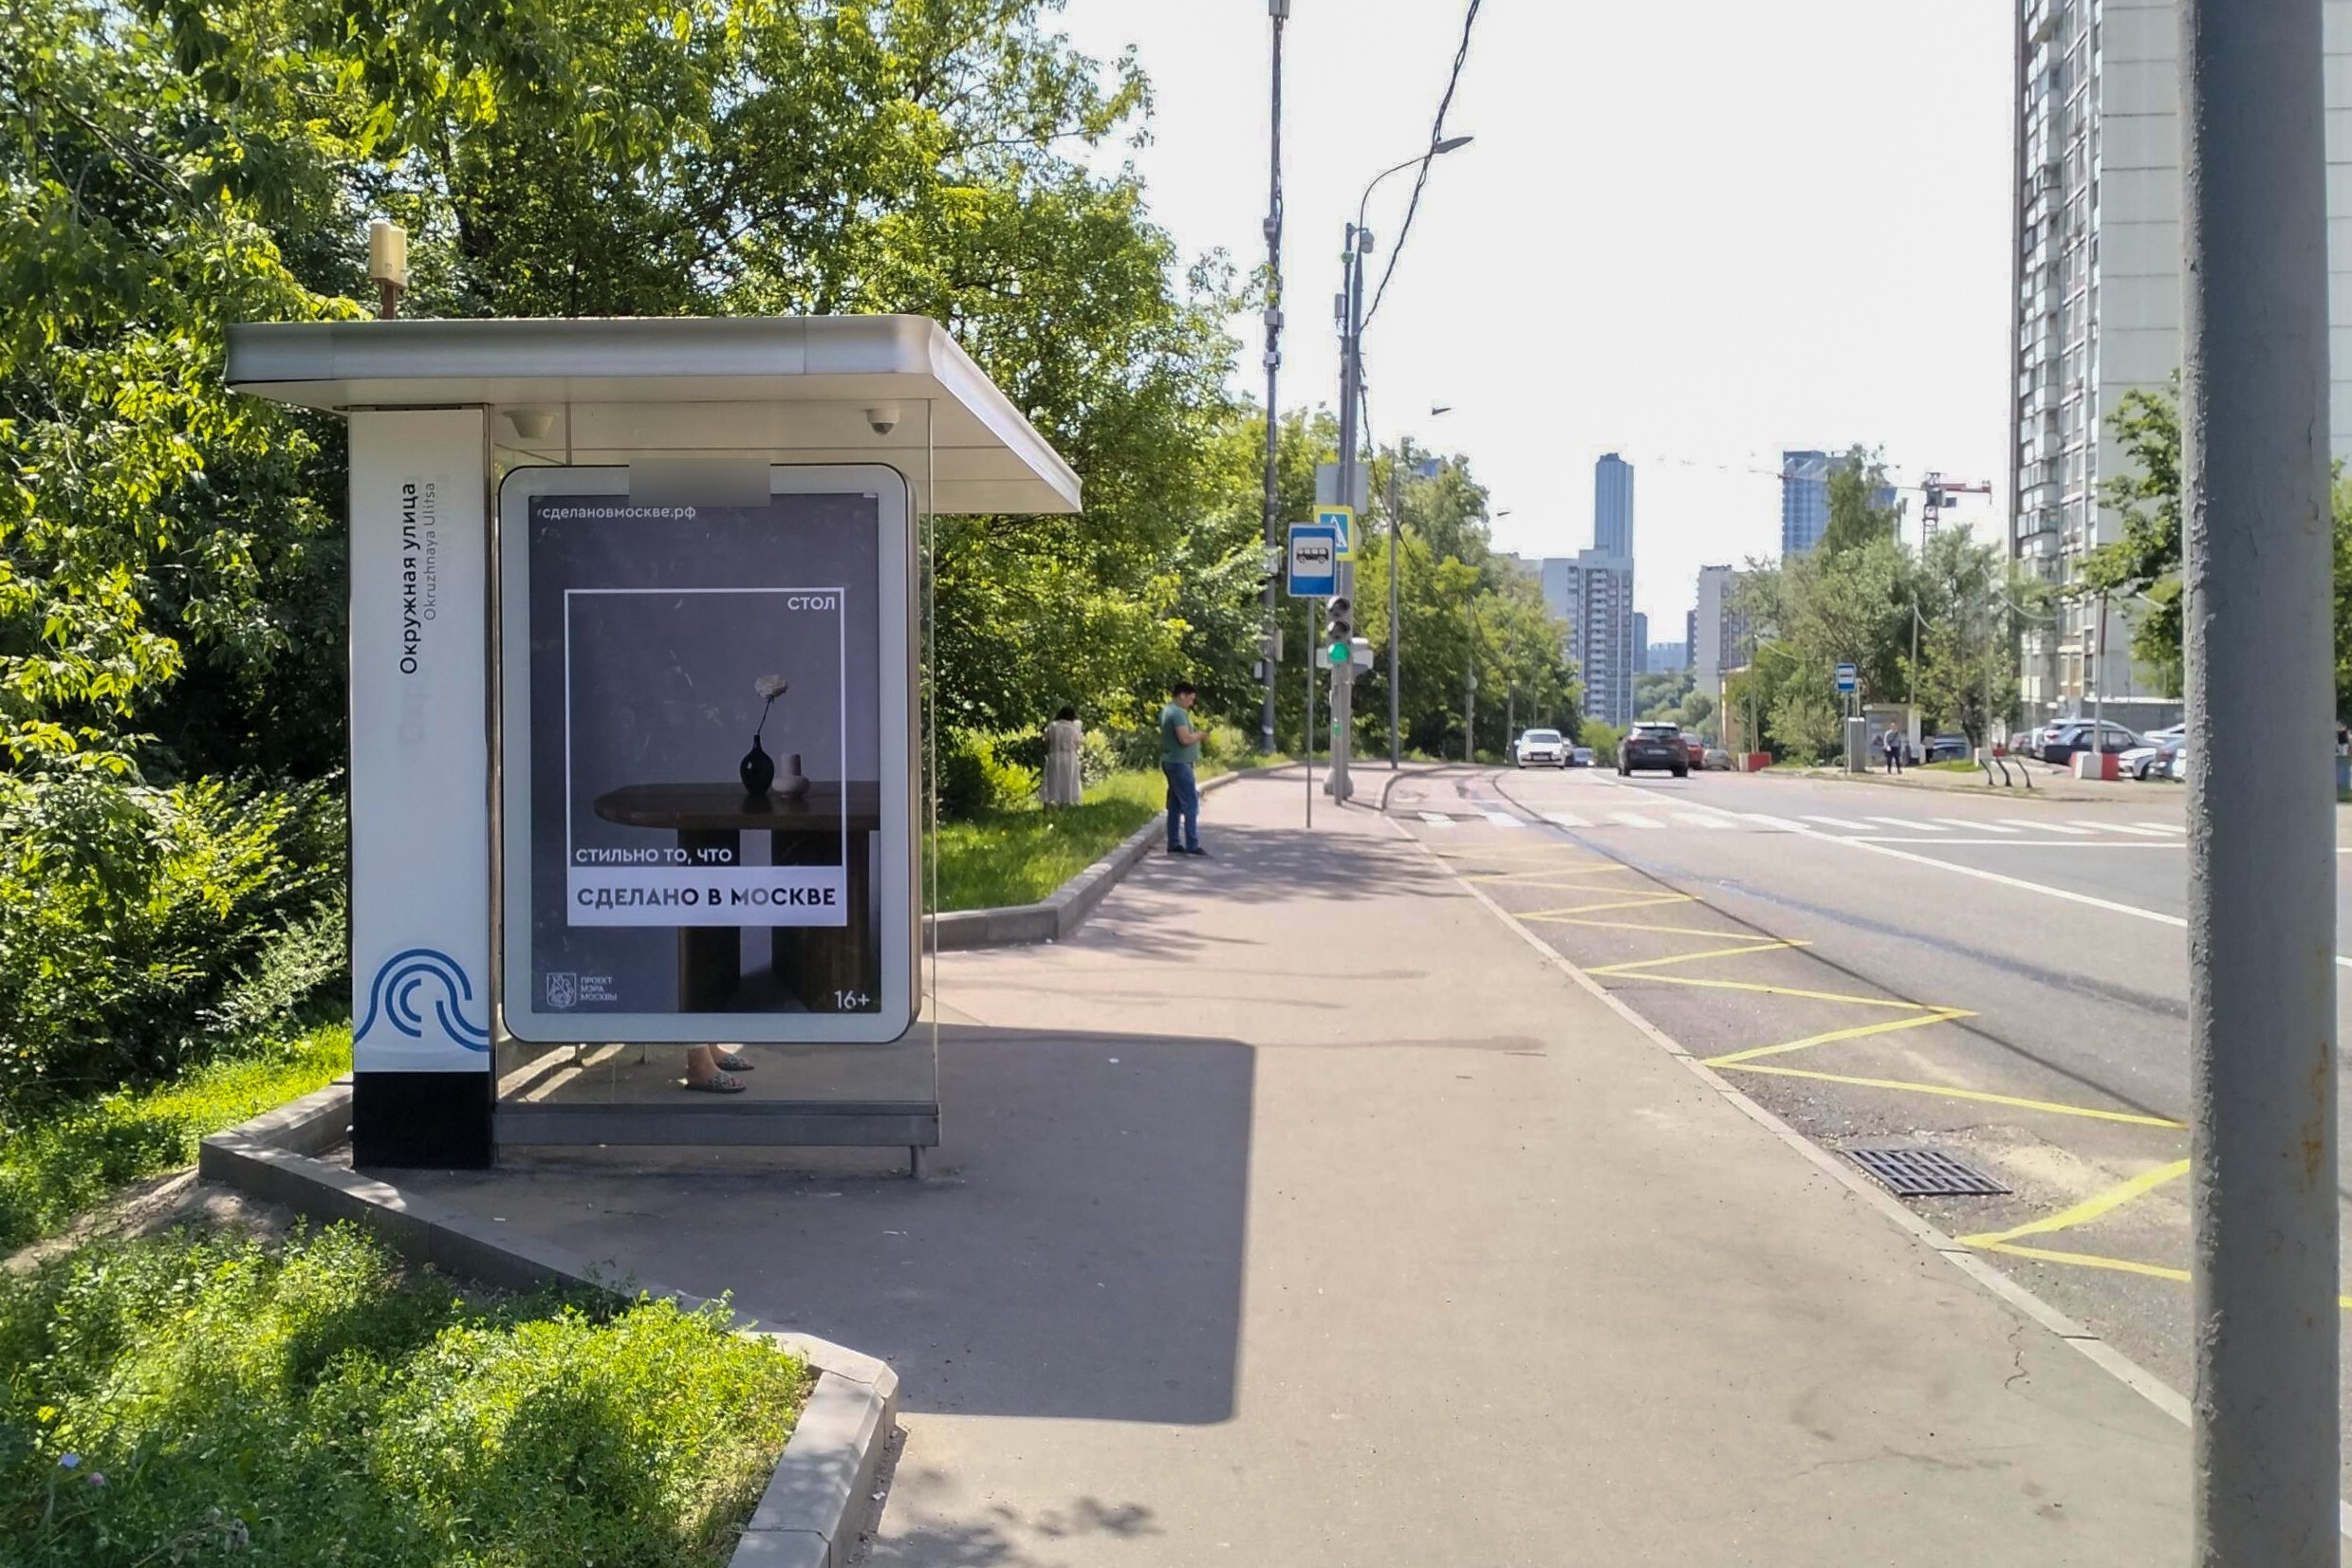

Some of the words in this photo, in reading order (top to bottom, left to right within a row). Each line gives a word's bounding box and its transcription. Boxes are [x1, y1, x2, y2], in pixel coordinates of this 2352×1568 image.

[423, 483, 435, 526] Ulitsa
[542, 507, 696, 521] сделановмоскве.рф
[402, 483, 420, 551] улица
[424, 531, 437, 620] Okruzhnaya
[787, 596, 836, 610] СТОЛ
[399, 558, 421, 674] Окружная
[575, 848, 659, 863] СТИЛЬНО
[663, 848, 693, 865] ТО,
[696, 848, 732, 863] ЧТО
[576, 887, 700, 910] СДЕЛАНО
[707, 887, 723, 906] В
[730, 887, 836, 907] МОСКВЕ
[833, 989, 871, 1009] 16+
